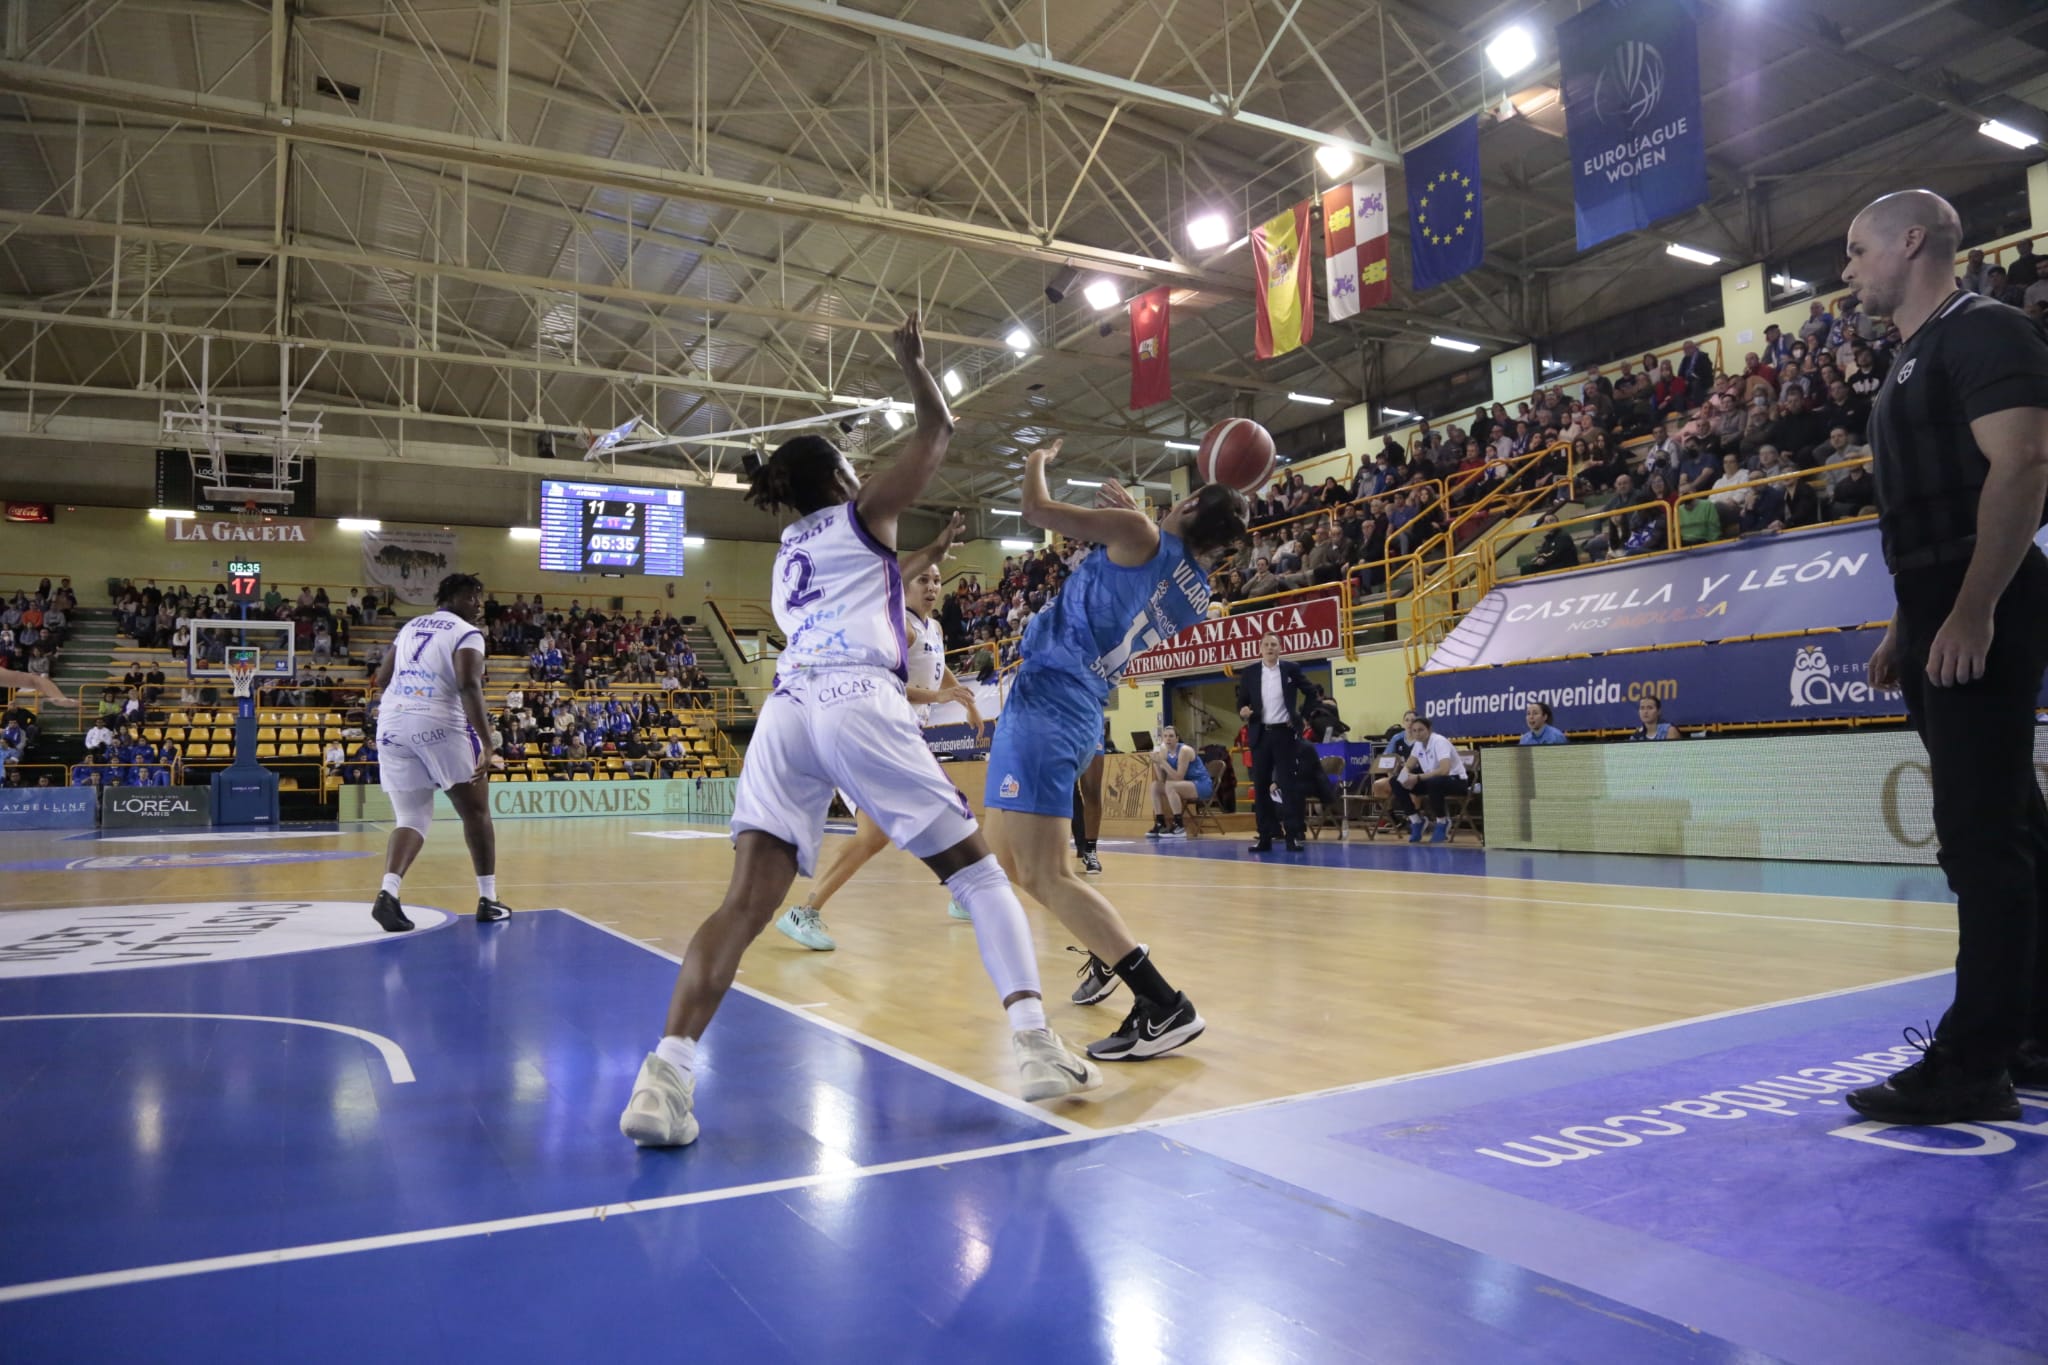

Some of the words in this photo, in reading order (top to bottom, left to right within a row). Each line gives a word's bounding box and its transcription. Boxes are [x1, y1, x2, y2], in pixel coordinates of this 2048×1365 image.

[1584, 117, 1688, 176] EUROLEAGUE
[1606, 146, 1666, 184] WOMEN
[588, 500, 606, 515] 11
[625, 502, 636, 517] 2
[174, 518, 208, 541] LA
[212, 521, 306, 542] GACETA
[591, 537, 635, 551] 05:35
[229, 562, 260, 572] 05:35
[593, 552, 602, 564] 0
[231, 578, 257, 595] 17
[782, 548, 826, 615] 2
[1505, 584, 1672, 623] CASTILLA
[1701, 575, 1731, 601] Y
[1738, 551, 1869, 592] LEÓN
[411, 618, 456, 631] JAMES
[1567, 617, 1609, 632] NOS
[408, 630, 437, 663] 7
[1199, 643, 1217, 664] DE
[1220, 639, 1238, 662] LA
[1241, 628, 1333, 659] HUNIDAD
[934, 662, 942, 680] 5
[819, 679, 877, 704] CICAR
[1425, 678, 1678, 719] perfumeriasavenida.com
[931, 735, 991, 752] meriasavenida.com
[2, 802, 87, 811] AYBELLINE
[113, 798, 197, 812] L'ORÉAL
[495, 787, 651, 814] CARTONAJES
